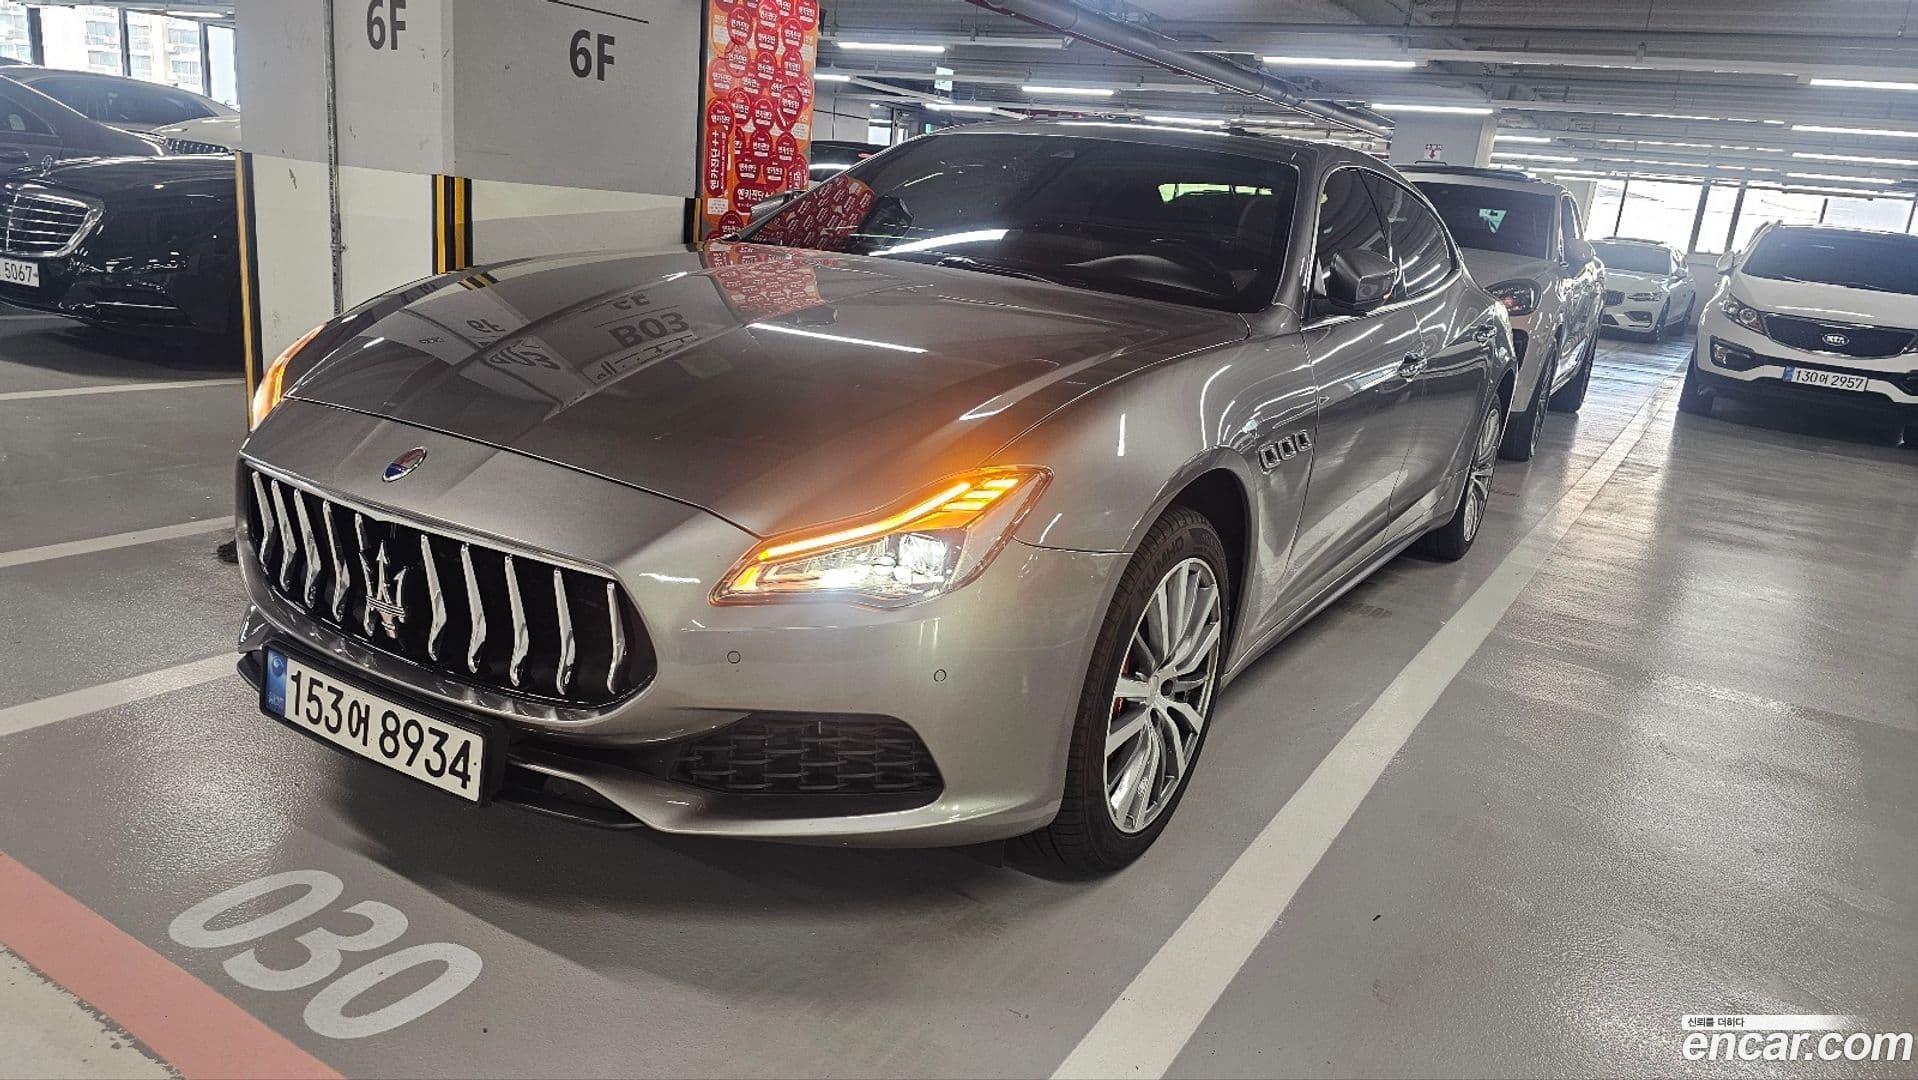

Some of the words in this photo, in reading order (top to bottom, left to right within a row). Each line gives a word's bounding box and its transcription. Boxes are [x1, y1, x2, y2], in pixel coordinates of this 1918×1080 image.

[366, 0, 407, 50] 6F
[569, 29, 615, 81] 6F
[4, 262, 32, 282] 5067
[1795, 370, 1828, 384] 130어
[1831, 375, 1864, 390] 2957
[291, 670, 370, 747] 153어
[379, 710, 471, 790] 8934
[168, 869, 483, 1039] 030
